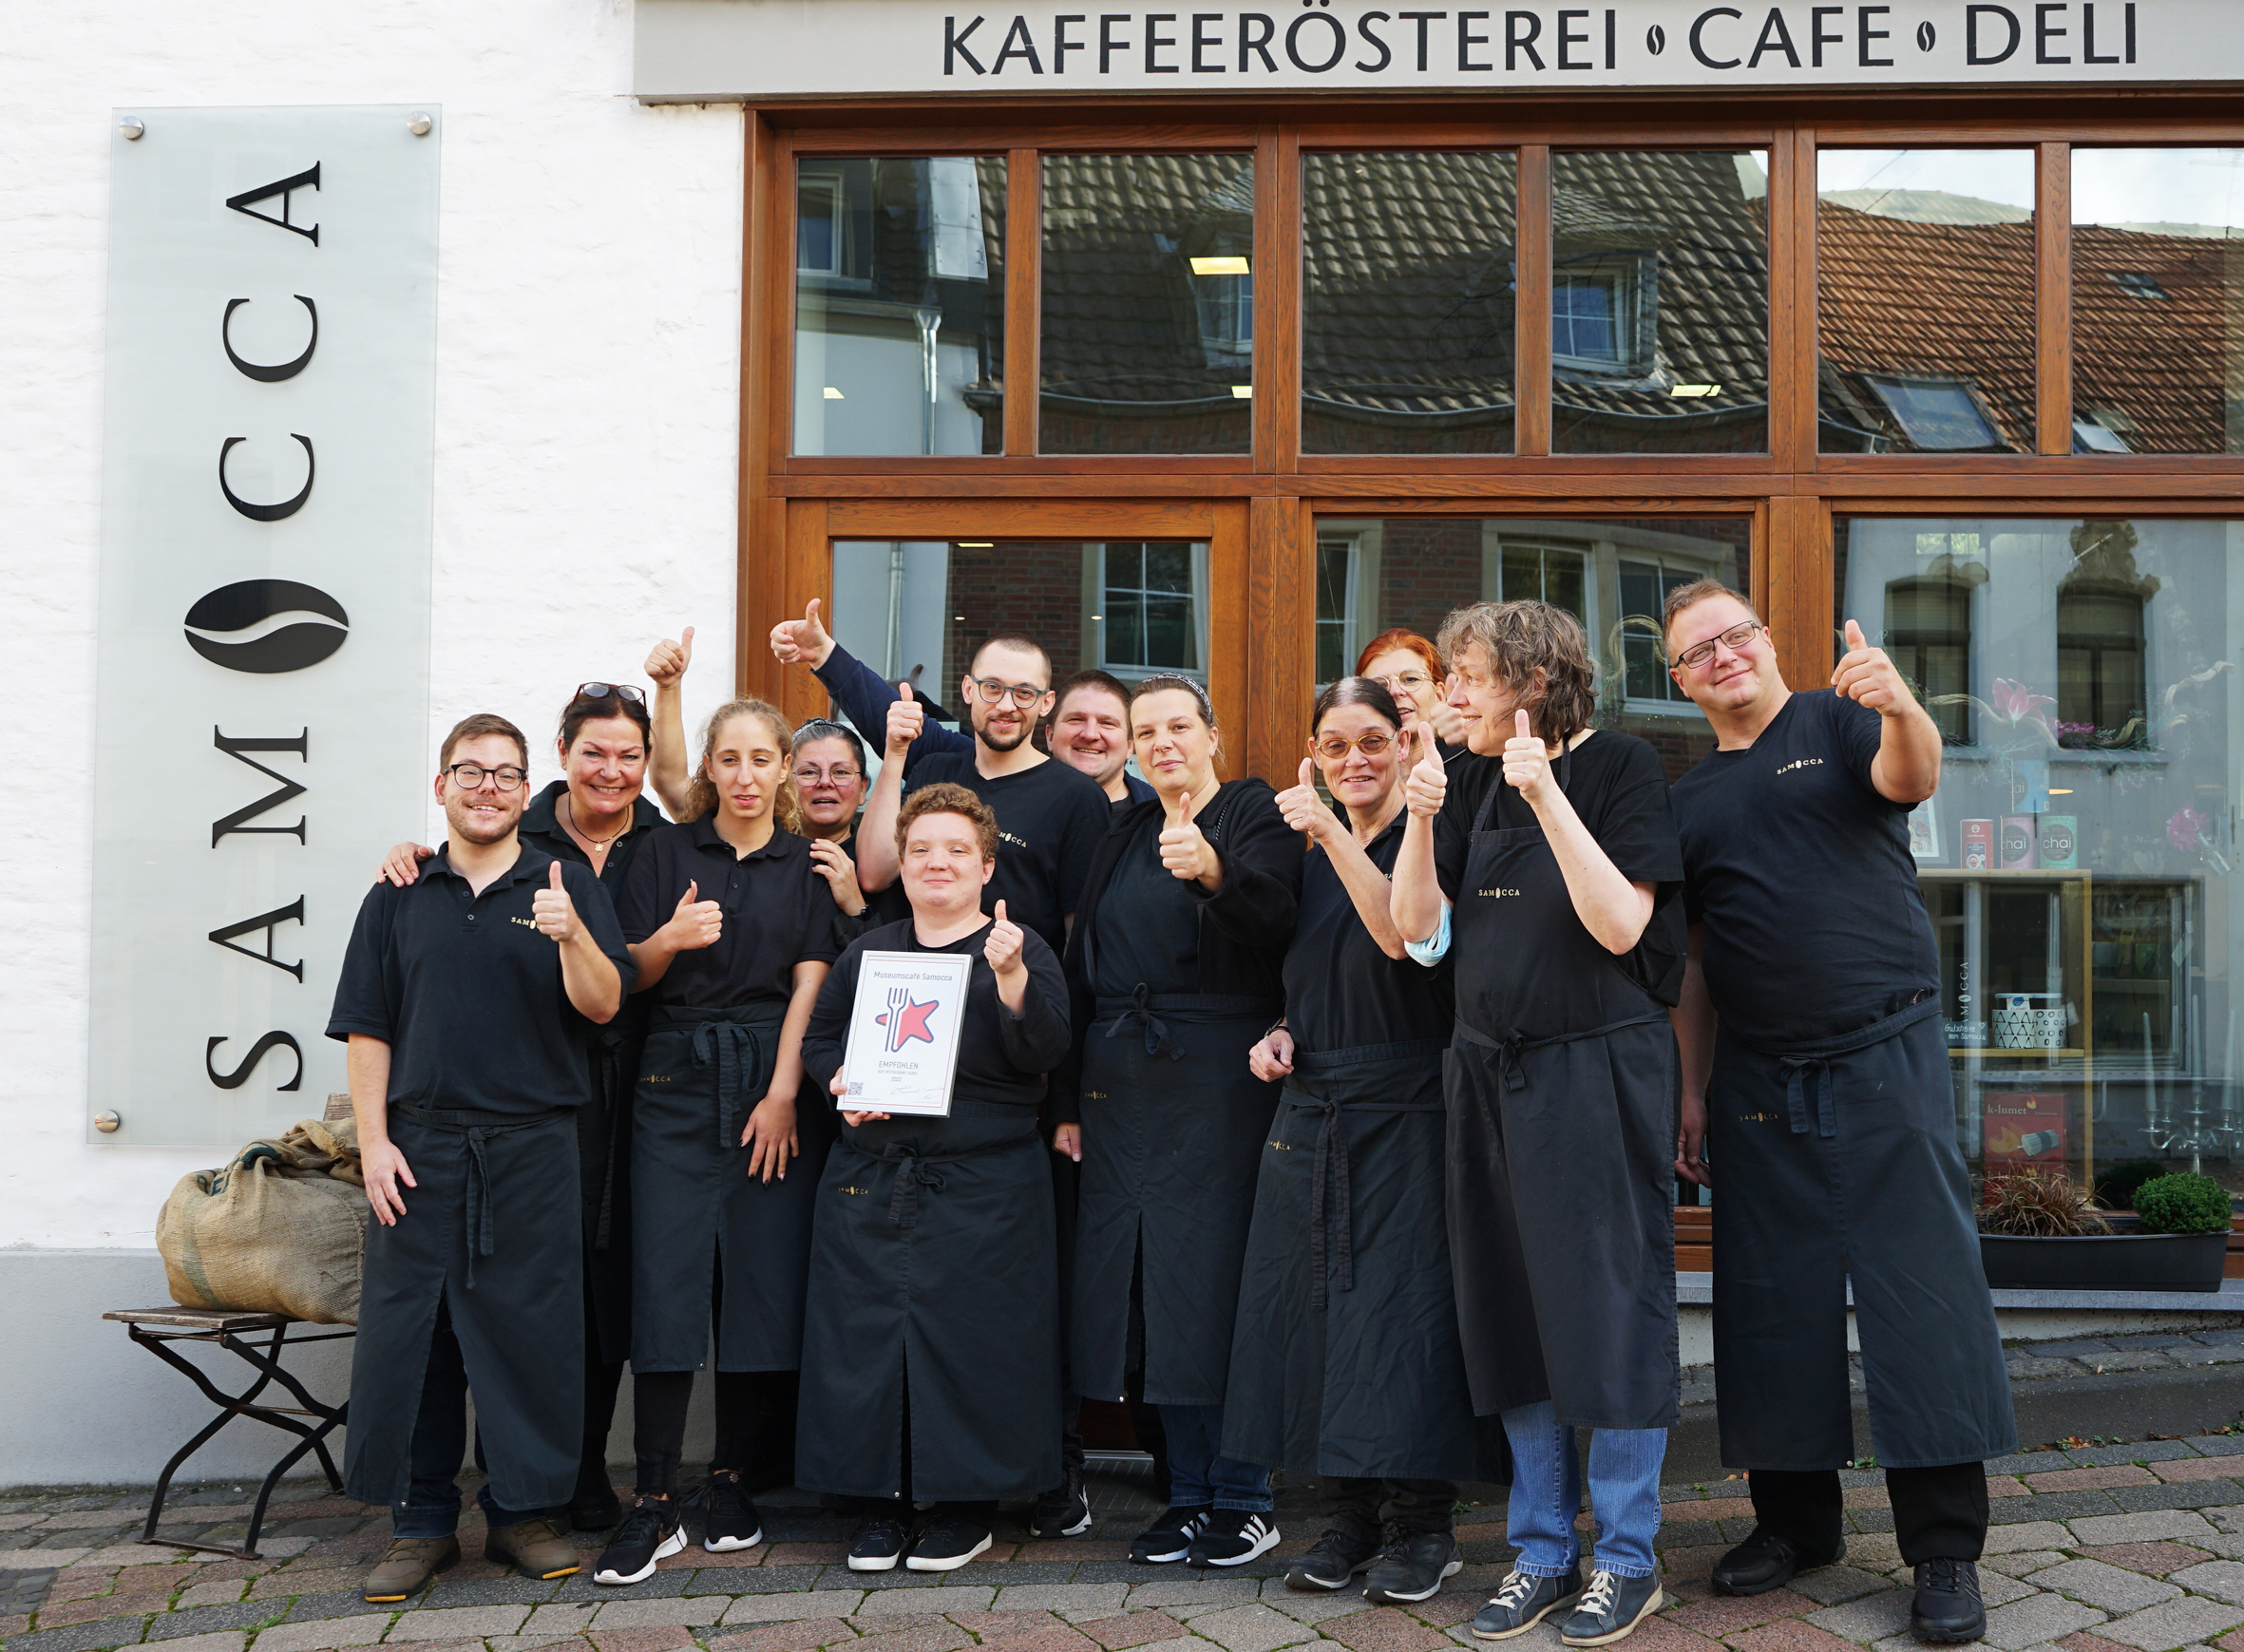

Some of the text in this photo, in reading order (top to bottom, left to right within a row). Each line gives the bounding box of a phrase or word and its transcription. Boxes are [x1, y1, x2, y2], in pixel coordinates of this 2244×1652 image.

[943, 0, 2137, 75] KAFFEERÖSTEREI CAFE DELI
[998, 831, 1027, 848] MOCCA
[2043, 836, 2072, 849] chai
[1477, 886, 1521, 900] SAMOCCA
[873, 971, 953, 982] Museumscafé Samocca
[878, 1060, 919, 1070] EMPFOHLEN
[1987, 1104, 2026, 1115] k-lumet
